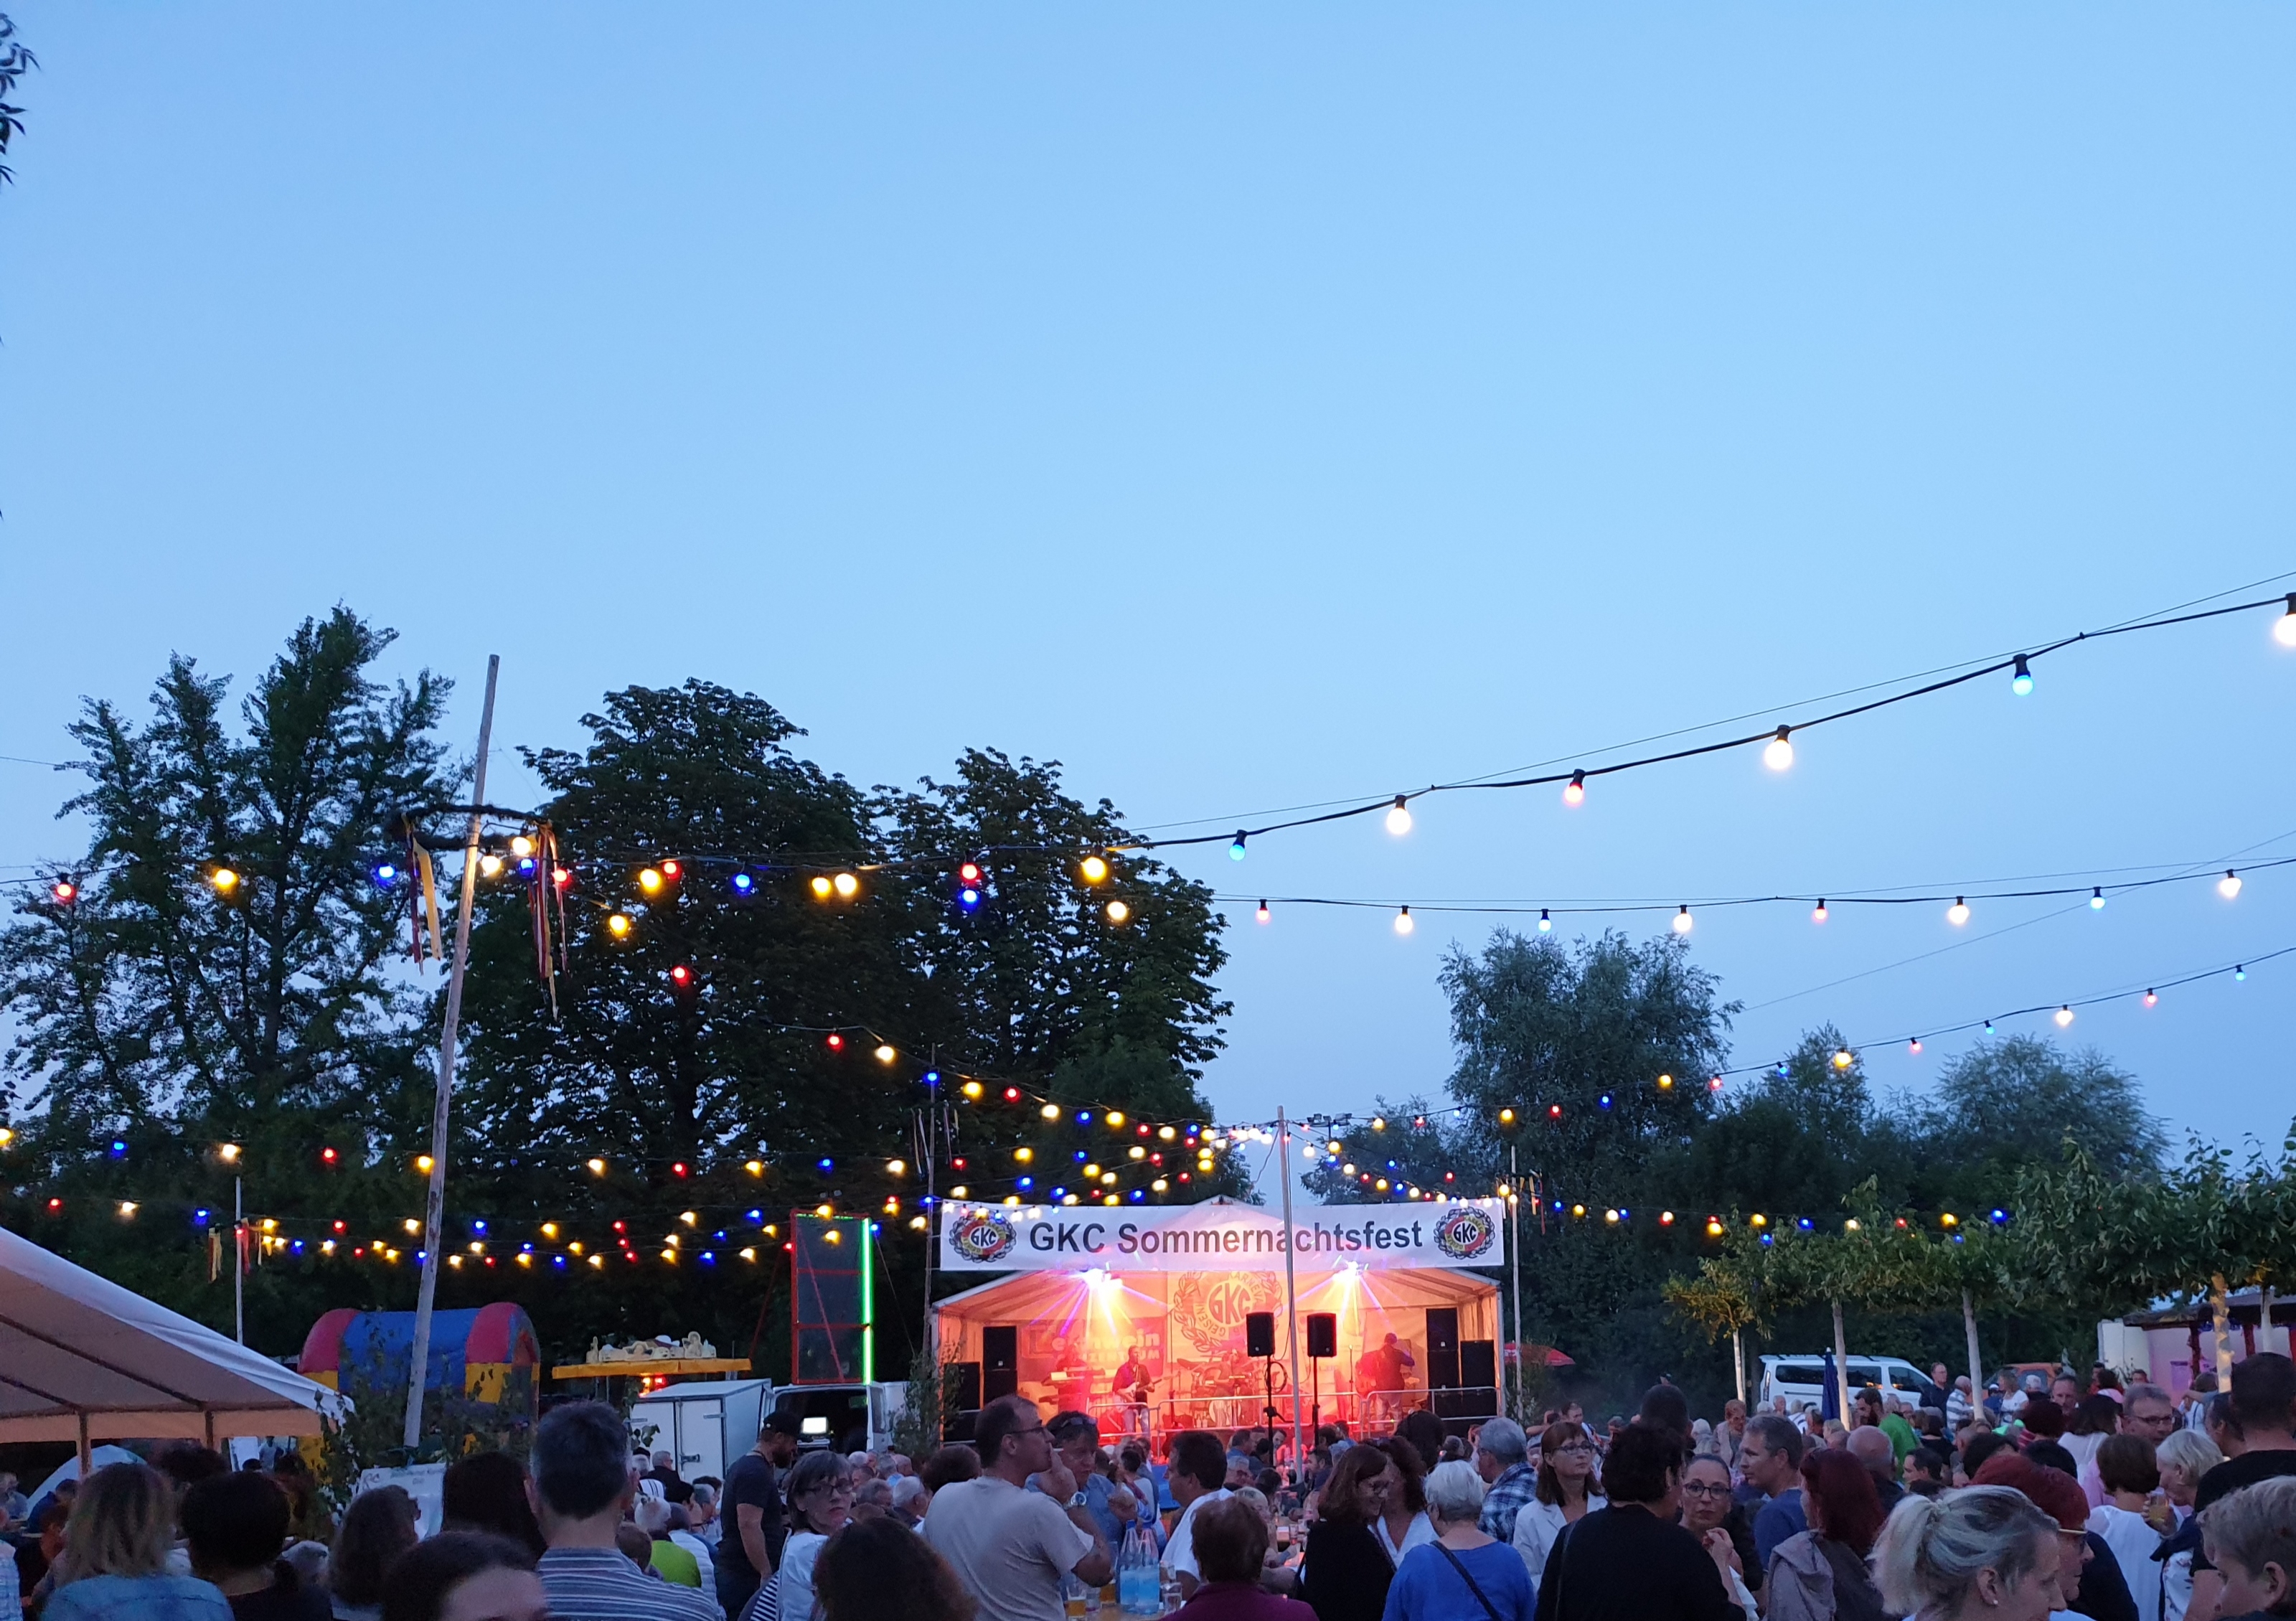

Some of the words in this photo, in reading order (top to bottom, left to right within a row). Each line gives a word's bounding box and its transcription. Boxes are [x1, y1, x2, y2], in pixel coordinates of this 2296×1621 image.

[970, 1227, 997, 1247] GKC
[1030, 1222, 1106, 1253] GKC
[1118, 1220, 1423, 1254] Sommernachtsfest
[1453, 1222, 1477, 1244] GKC
[1208, 1282, 1251, 1325] GKC
